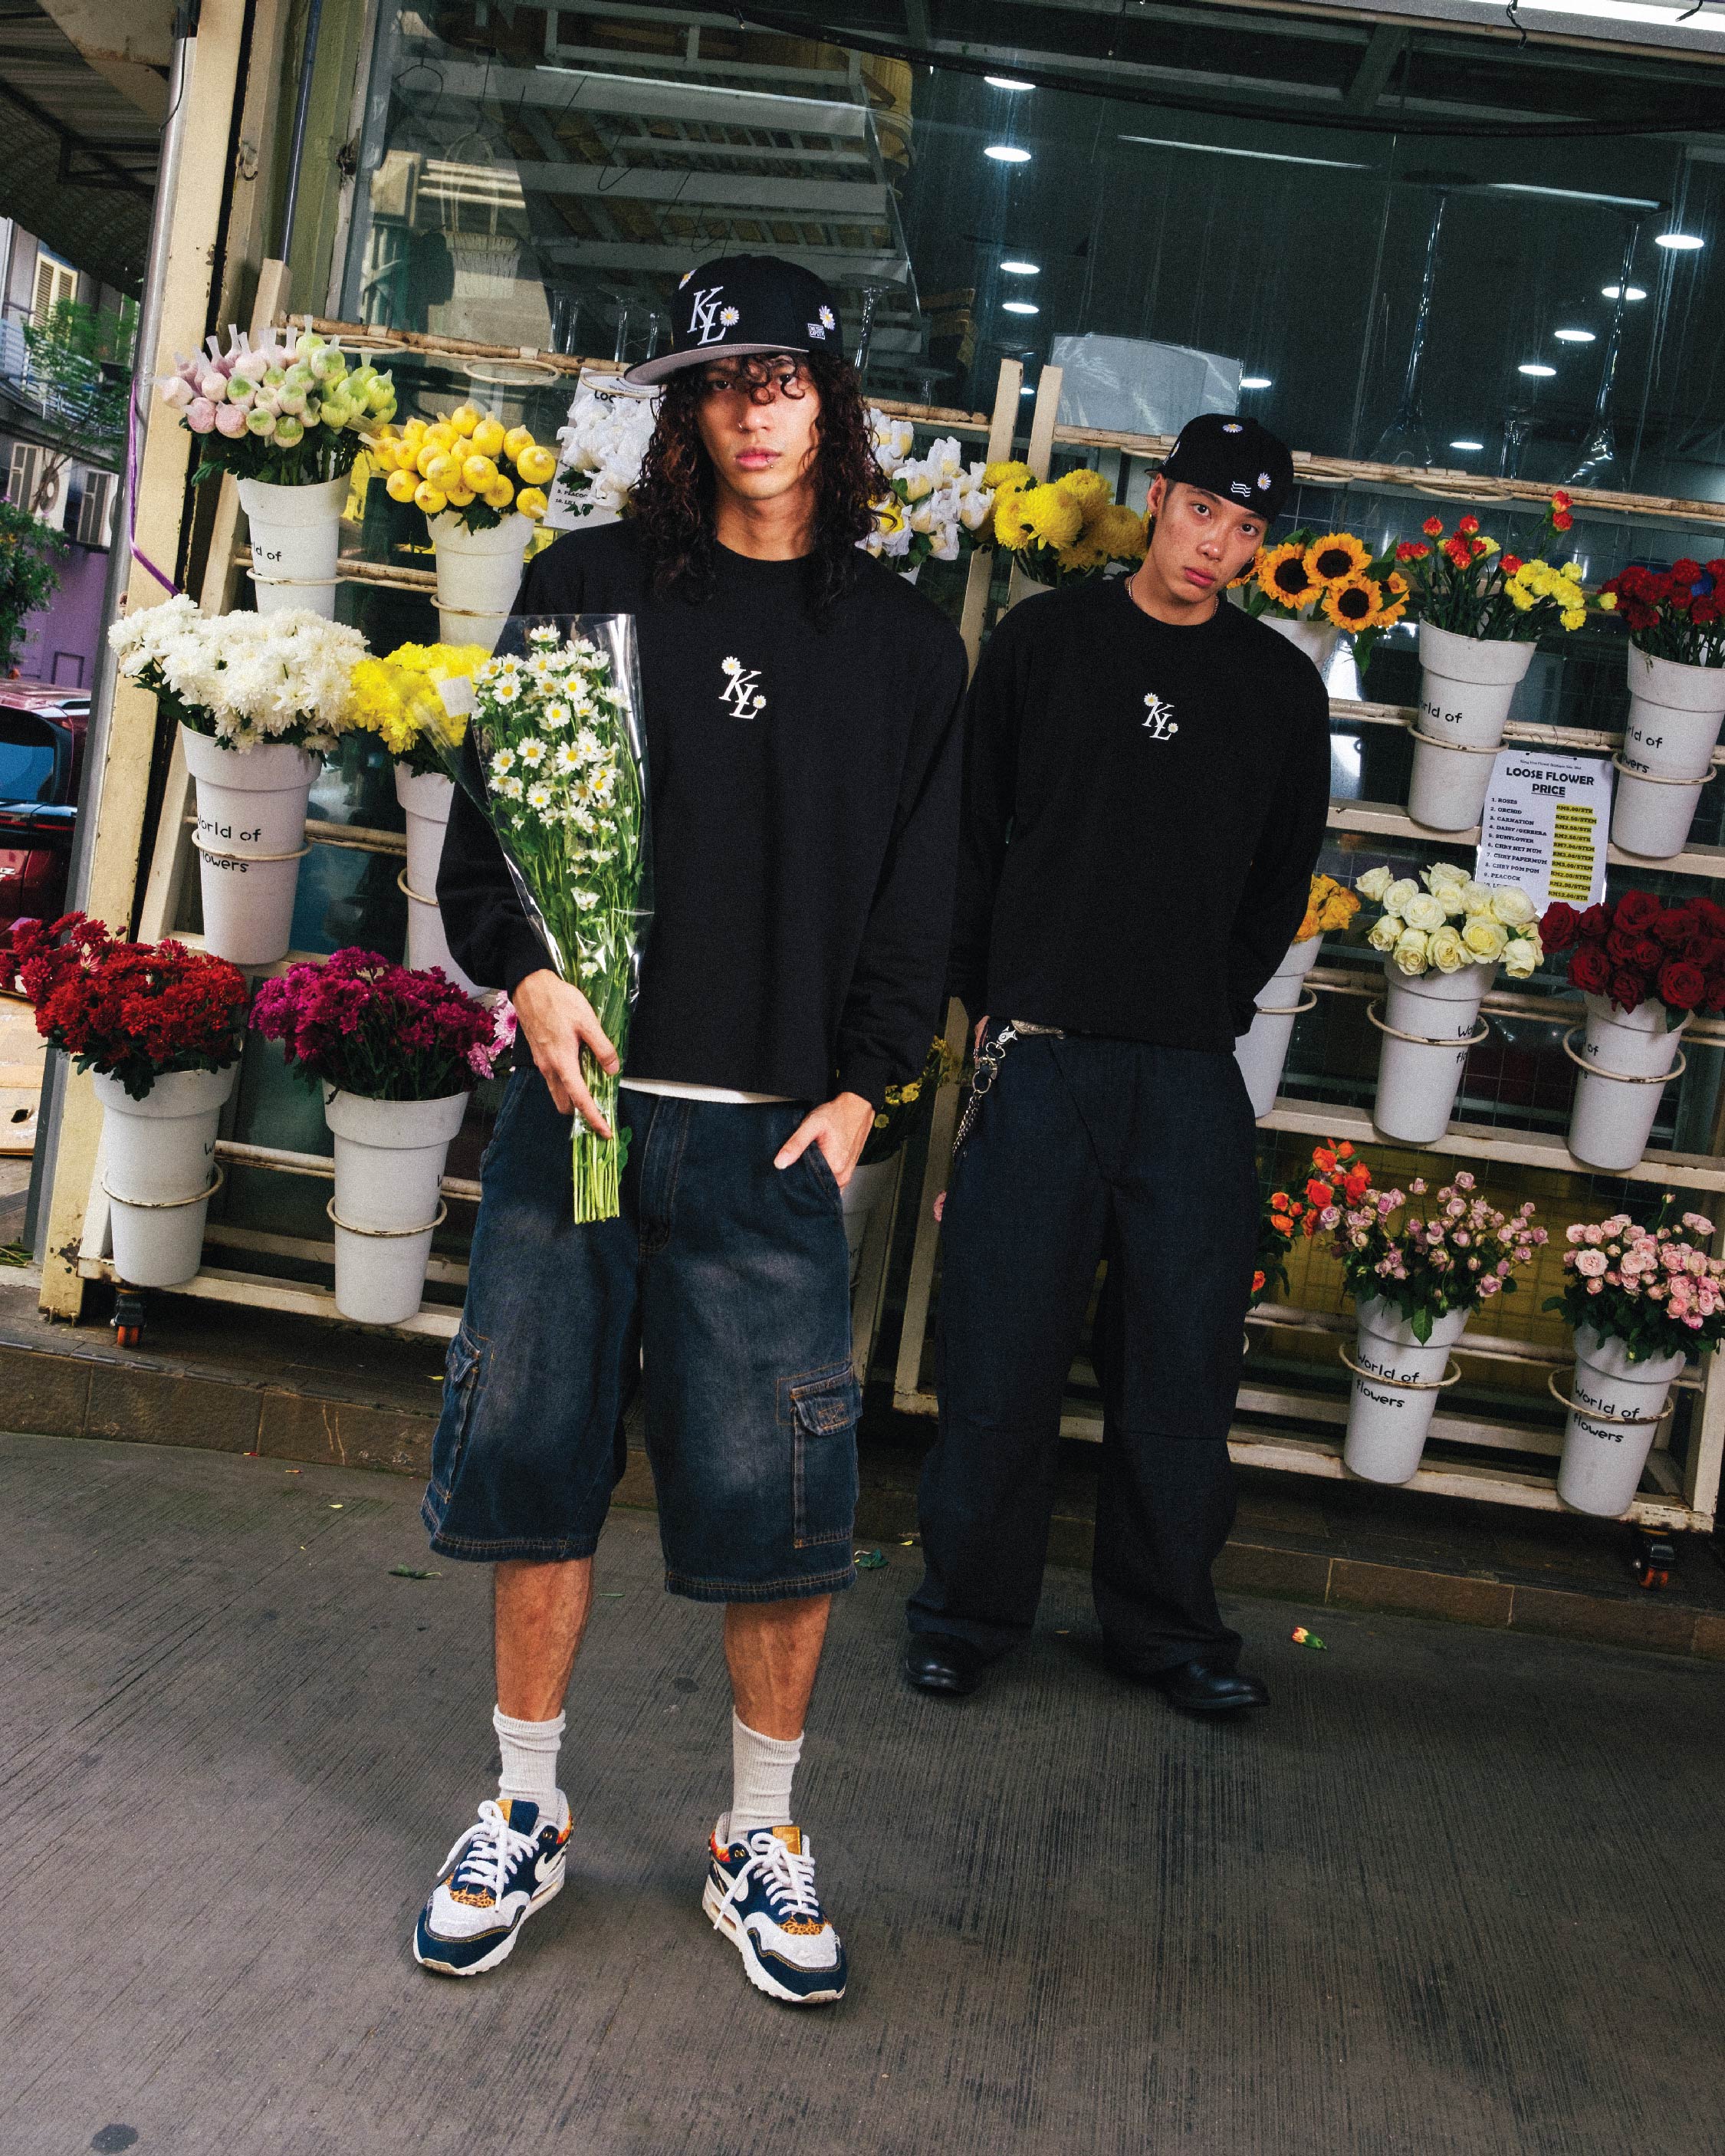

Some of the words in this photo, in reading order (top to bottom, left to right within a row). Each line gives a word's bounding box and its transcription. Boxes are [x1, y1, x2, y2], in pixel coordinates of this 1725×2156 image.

[267, 551, 281, 561] of
[1445, 712, 1463, 723] of
[1646, 737, 1662, 748] of
[1506, 767, 1543, 780] LOOSE
[1546, 771, 1595, 785] FLOWER
[1532, 783, 1566, 796] PRICE
[1497, 817, 1534, 826] CARNATION
[240, 828, 261, 842] of
[1495, 834, 1534, 843] SUNFLOWER
[200, 849, 249, 873] lowers
[1491, 873, 1521, 882] PEACOCK
[1587, 1043, 1599, 1057] of
[1401, 1372, 1420, 1382] of
[1357, 1379, 1405, 1408] flowers
[1621, 1408, 1640, 1418] of
[1574, 1412, 1625, 1443] flowers
